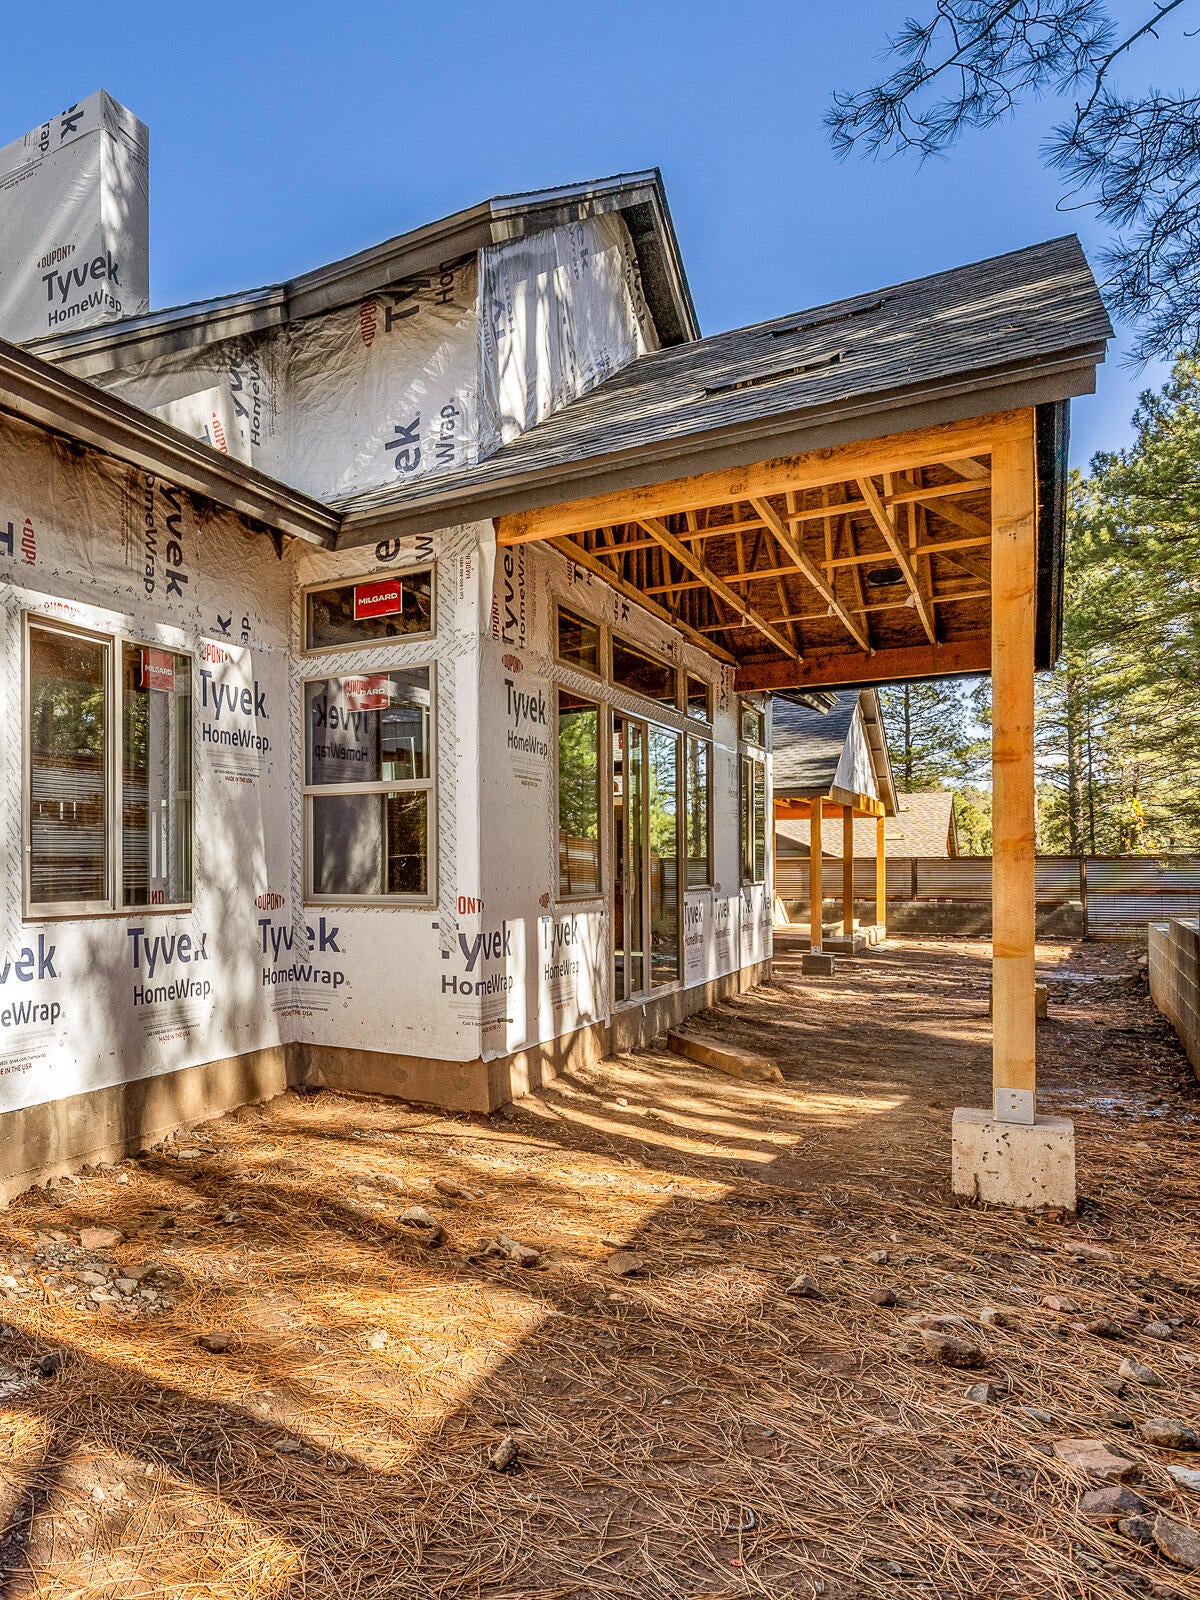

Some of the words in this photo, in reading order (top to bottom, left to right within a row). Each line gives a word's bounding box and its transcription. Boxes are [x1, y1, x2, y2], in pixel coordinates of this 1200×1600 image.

[41, 244, 71, 268] DUPONT
[42, 251, 119, 303] Tyvek
[48, 289, 122, 327] HomeWrap
[357, 592, 398, 605] MILGARD
[144, 664, 173, 676] MILGARD
[200, 668, 267, 720] Tyvek
[346, 687, 386, 698] MILGARD
[504, 679, 546, 727] Tyvek
[202, 722, 269, 754] HomeWrap
[507, 731, 548, 758] HomeWrap
[258, 893, 282, 911] DUPONT
[541, 913, 578, 958] Tyvek
[127, 928, 208, 978] Tyvek
[262, 964, 345, 988] HomeWrap
[544, 959, 579, 980] HomeWrap
[133, 978, 211, 1006] HomeWrap
[441, 974, 513, 997] HomeWrap
[11, 1065, 21, 1073] THE
[21, 1062, 32, 1071] USA
